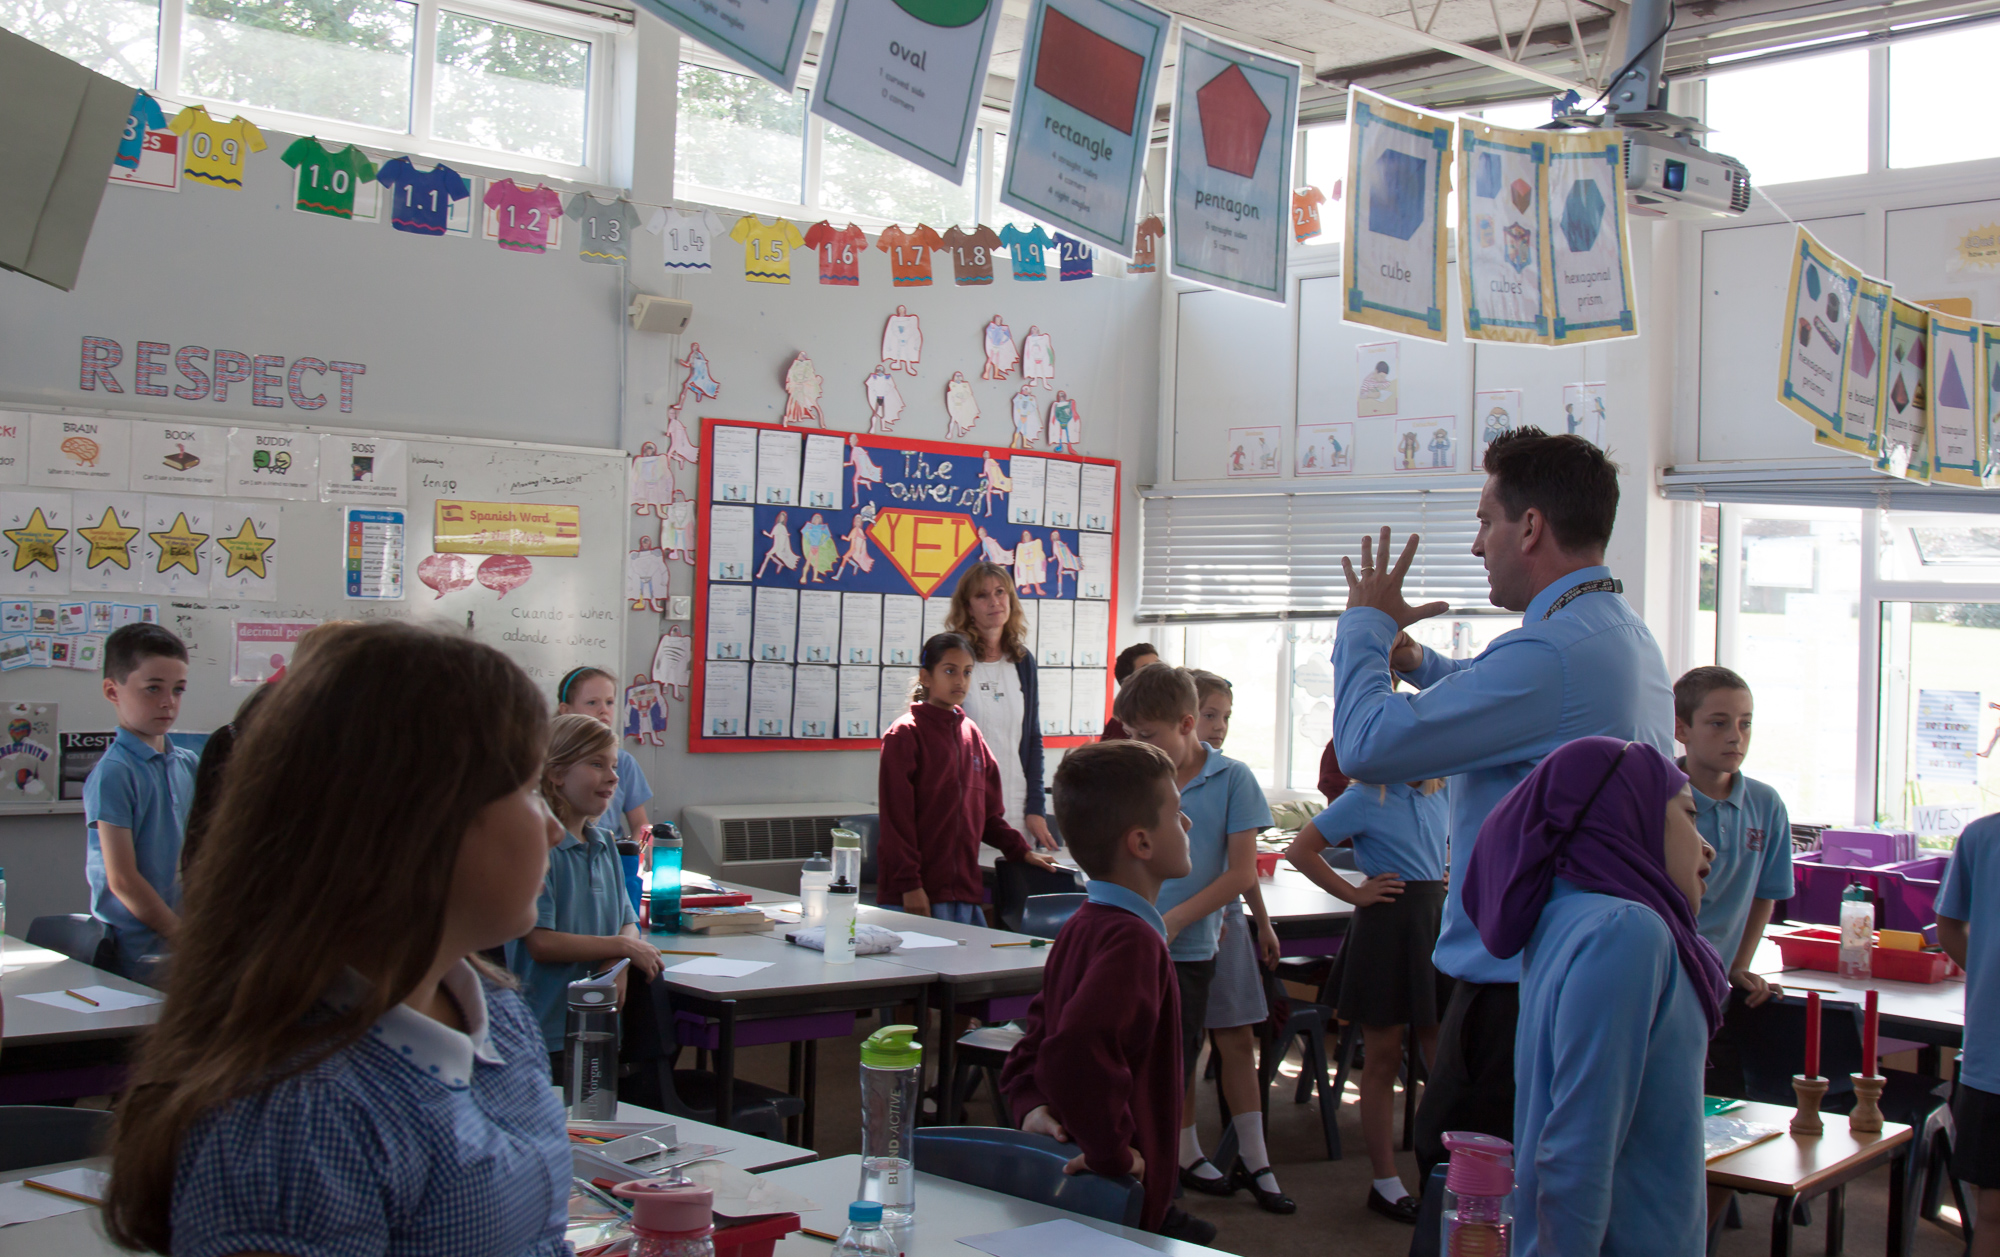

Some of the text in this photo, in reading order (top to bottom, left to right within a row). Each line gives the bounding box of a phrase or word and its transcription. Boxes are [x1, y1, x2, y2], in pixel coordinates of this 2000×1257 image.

[889, 40, 927, 72] oval
[192, 132, 240, 165] 0.9
[1044, 115, 1113, 161] rectangle
[309, 164, 350, 194] 1.0
[403, 184, 440, 213] 1.1
[1195, 189, 1260, 222] pentagon
[506, 204, 542, 232] 1.2
[1295, 207, 1319, 226] 2.4
[588, 216, 622, 242] 1.3
[668, 227, 705, 252] 1.4
[751, 237, 784, 263] 1.5
[824, 242, 854, 266] 1.6
[894, 245, 924, 266] 1.7
[956, 245, 987, 267] 1.8
[1013, 242, 1041, 263] 1.9
[1063, 242, 1090, 261] 2.0
[1380, 261, 1412, 283] cube
[1563, 267, 1612, 288] hexagonal
[1489, 275, 1523, 295] cubes
[1577, 293, 1603, 312] prism
[79, 335, 367, 414] RESPECT
[1798, 349, 1834, 383] hexagonal
[1802, 376, 1825, 397] prisms
[62, 422, 99, 434] BRAIN
[164, 429, 196, 442] BOOK
[256, 435, 294, 447] BUDDY
[351, 442, 376, 454] BOSS
[901, 449, 953, 480] The
[469, 509, 551, 524] Spanish Word
[886, 512, 967, 578] YET
[579, 605, 614, 621] when
[239, 626, 283, 638] decimal
[502, 627, 550, 645] adonde
[566, 633, 608, 649] where
[1918, 807, 1975, 831] WEST
